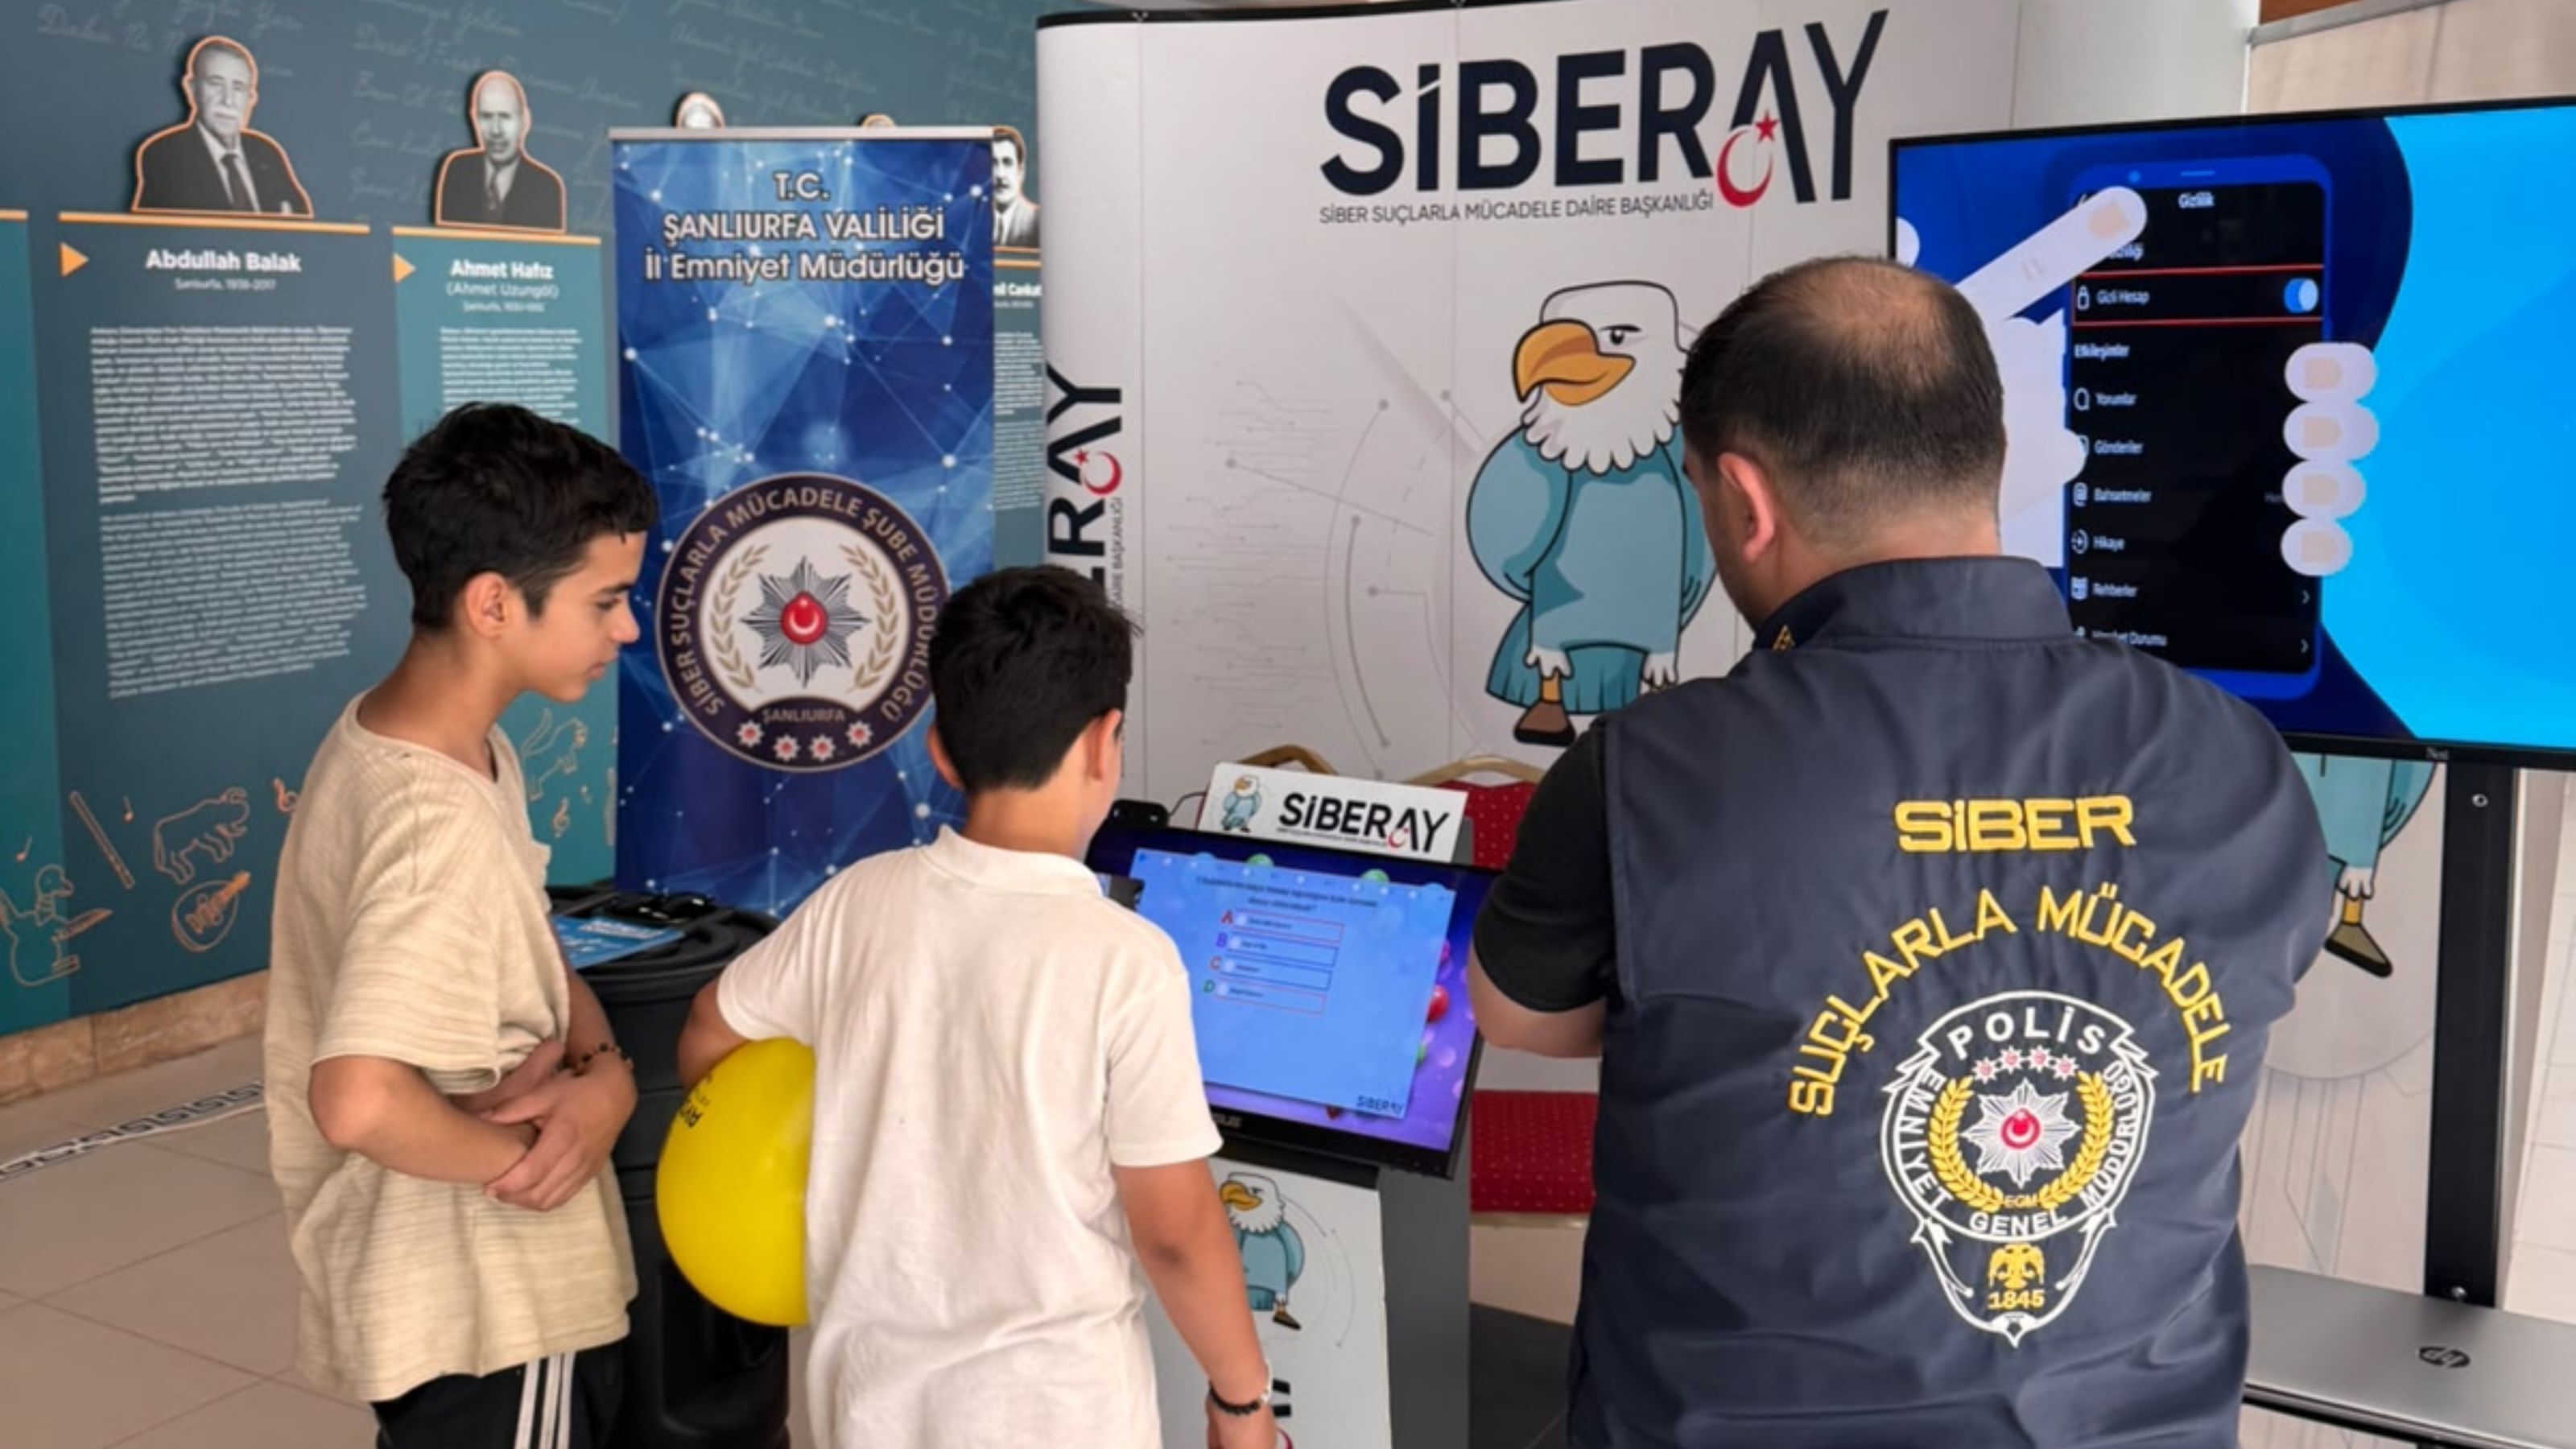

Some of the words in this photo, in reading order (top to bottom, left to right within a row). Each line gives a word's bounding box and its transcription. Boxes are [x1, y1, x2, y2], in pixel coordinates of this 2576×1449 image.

[774, 171, 829, 200] T.C.
[1319, 202, 1368, 225] SİBER
[1372, 201, 1460, 226] SUÇLARLA
[1464, 198, 1562, 221] MÜCADELE
[1565, 195, 1616, 217] DAİRE
[1620, 188, 1715, 219] BAŞKANLIĞI
[663, 212, 818, 247] ŞANLIURFA
[824, 205, 945, 240] VALİLİĞİ
[145, 248, 242, 270] Abdullah
[245, 251, 302, 272] Balak
[450, 258, 508, 279] Ahmet
[645, 247, 662, 280] İl
[671, 250, 791, 285] Emniyet
[799, 250, 965, 287] Müdürlüğü
[446, 282, 497, 297] (Ahmet
[726, 485, 862, 528] MÜCADELE
[861, 507, 918, 562] ŞUBE
[671, 525, 728, 646] SUÇLARLA
[675, 650, 725, 716] SİBER
[762, 708, 846, 724] ŞANLIURFA
[1220, 909, 1233, 924] A
[1216, 932, 1228, 947] B
[1209, 956, 1222, 971] C
[1786, 887, 2018, 1117] SUÇLARLA
[2037, 881, 2231, 1093] MÜCADELE
[1946, 1005, 2105, 1060] POLİS
[1970, 1208, 2067, 1237] GENEL
[1988, 1290, 2046, 1311] 1845
